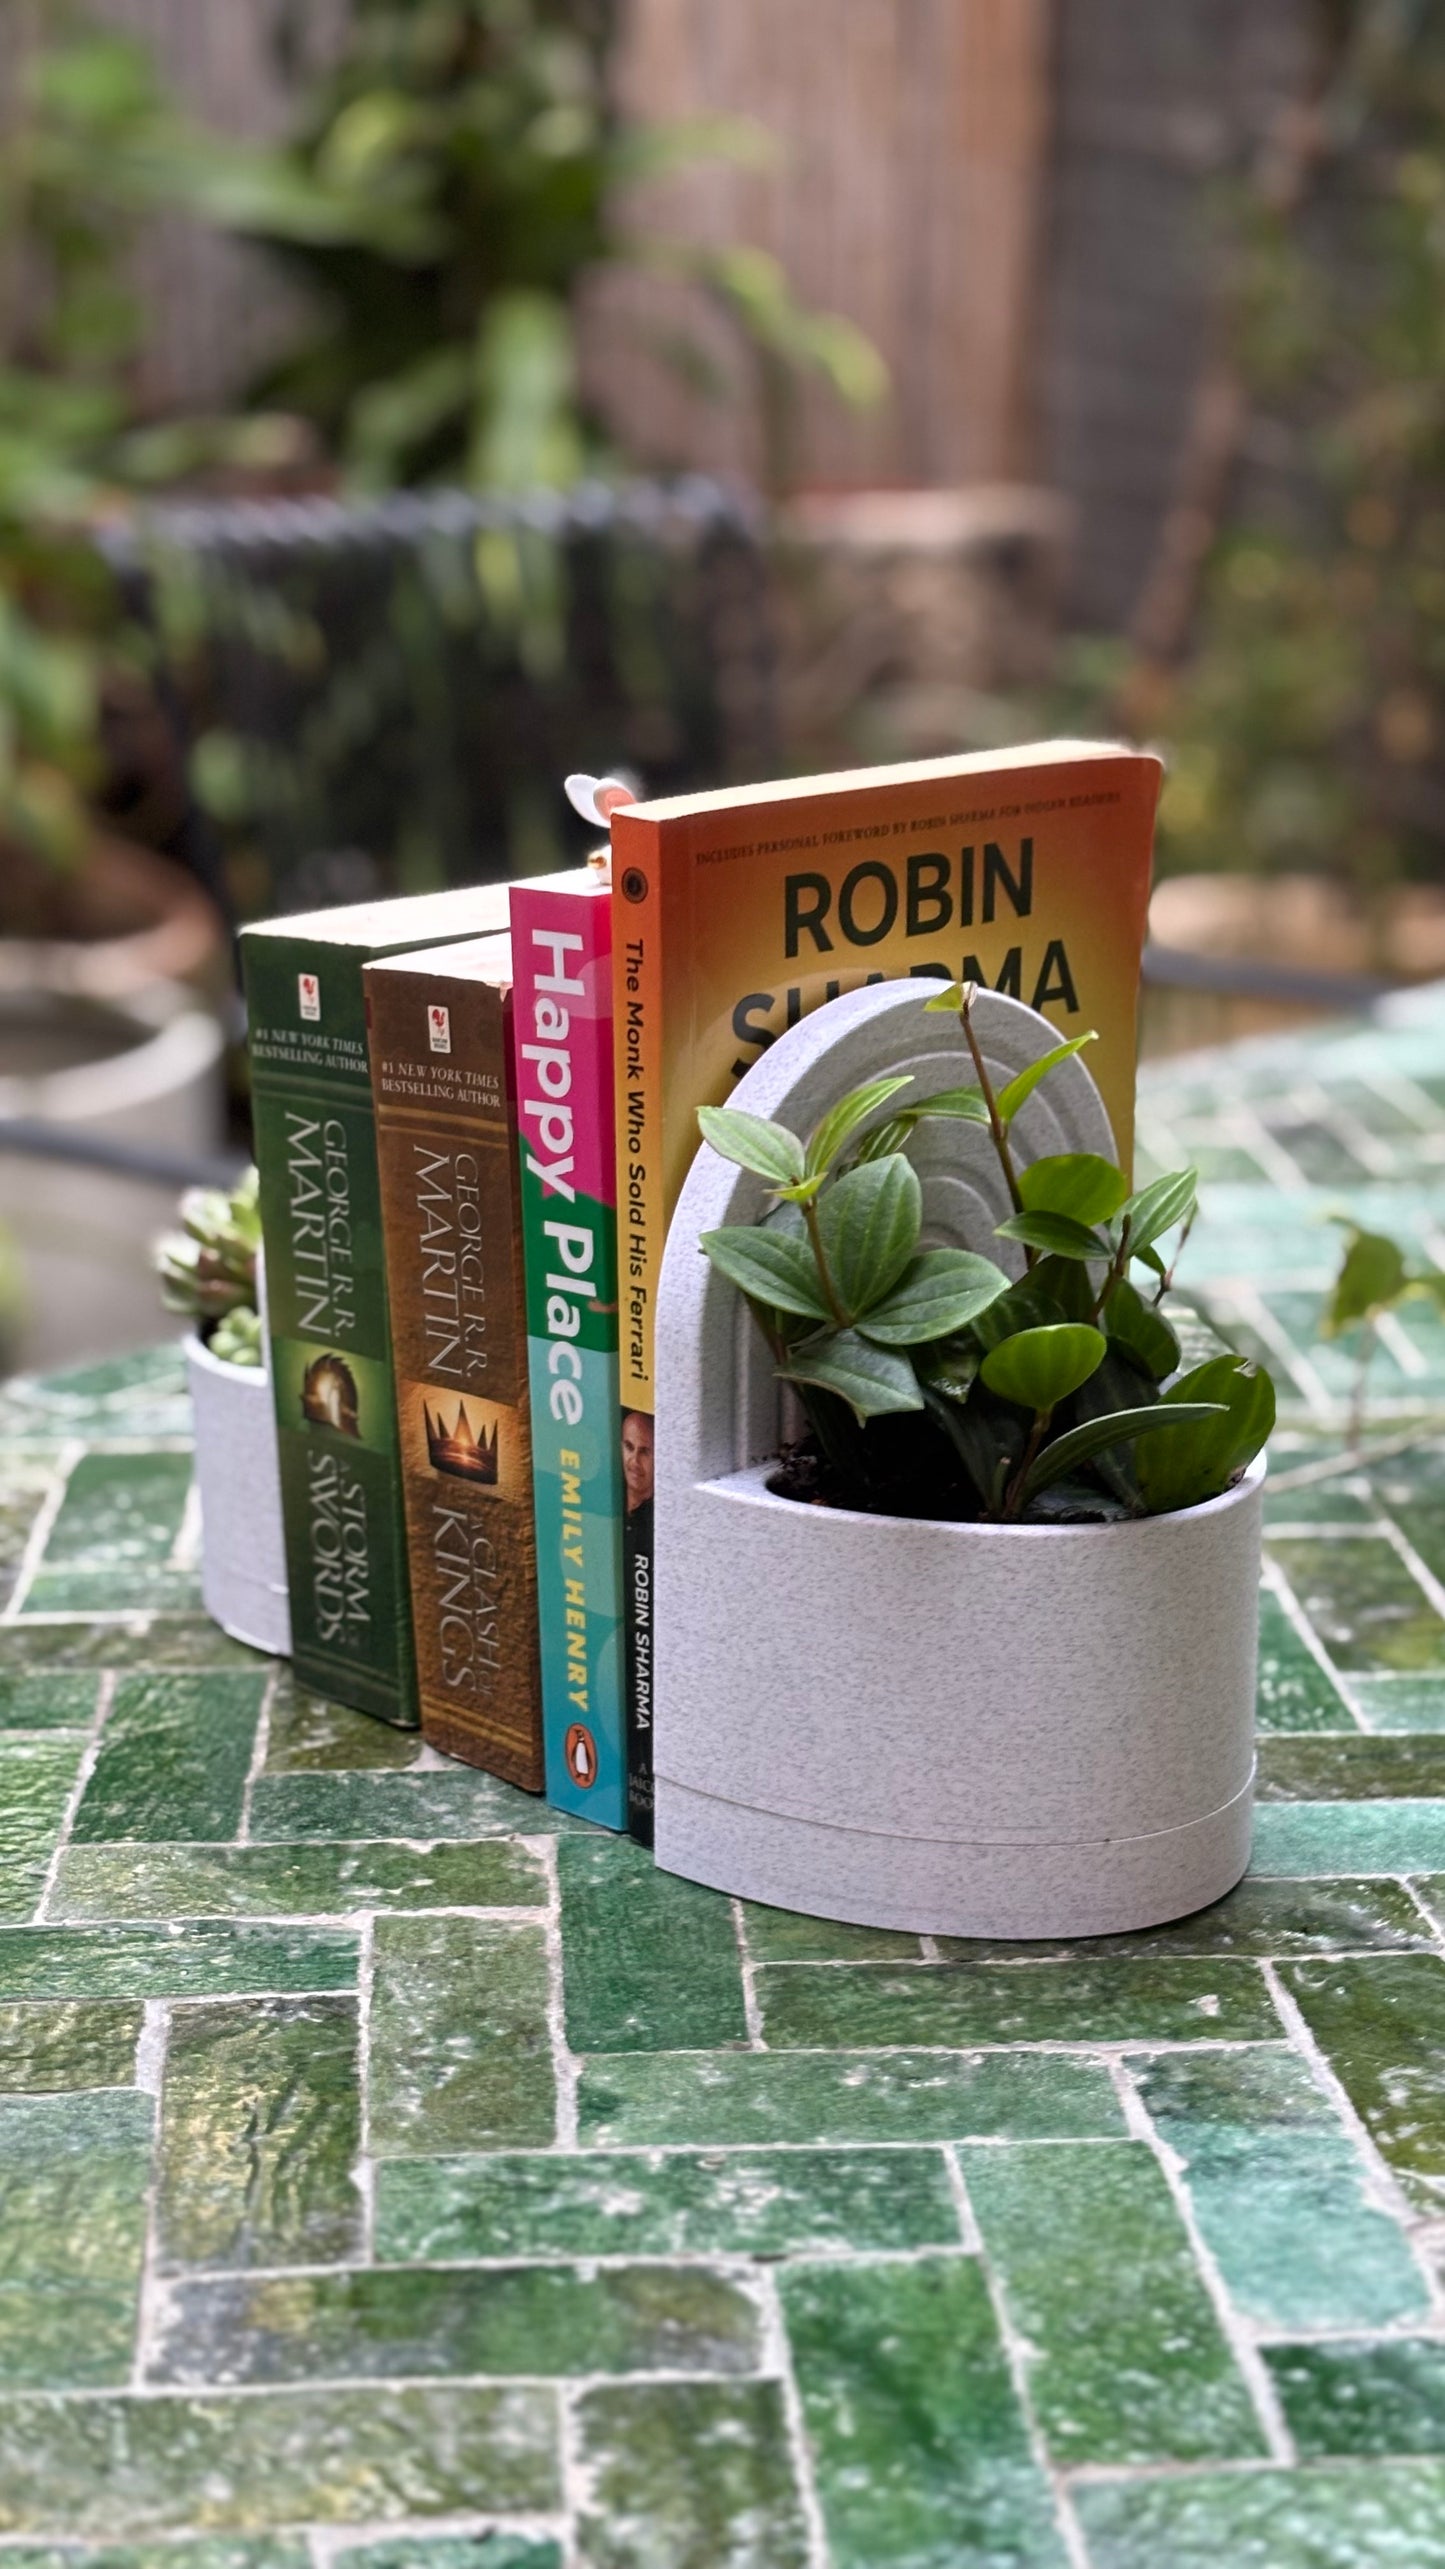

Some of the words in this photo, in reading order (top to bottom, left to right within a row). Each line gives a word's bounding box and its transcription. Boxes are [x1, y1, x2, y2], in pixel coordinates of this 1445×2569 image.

[758, 834, 819, 856] PERSONAL
[822, 823, 889, 846] FOREWORD
[893, 820, 907, 835] BY
[910, 815, 946, 831] ROBIN
[783, 837, 1033, 959] ROBIN
[626, 937, 644, 992] The
[252, 1044, 323, 1066] BESTSELLING
[324, 1054, 369, 1074] AUTHOR
[271, 1029, 299, 1044] NEW
[301, 1033, 331, 1050] YORK
[331, 1038, 364, 1056] TIMES
[381, 1061, 393, 1075] #1
[398, 1062, 427, 1078] NEW
[430, 1066, 463, 1084] YORK
[464, 1071, 499, 1090] TIMES
[381, 1078, 454, 1100] BESTSELLING
[456, 1089, 501, 1108] AUTHOR
[522, 927, 586, 1204] Happy
[626, 1001, 645, 1081] Monk
[627, 1090, 645, 1154] Who
[284, 1110, 333, 1336] MARTIN
[323, 1119, 353, 1264] GEORGE
[454, 1153, 485, 1303] GEORGE
[628, 1162, 647, 1226] Sold
[413, 1144, 463, 1377] MARTIN
[629, 1233, 647, 1277] His
[543, 1220, 596, 1427] Place
[630, 1285, 649, 1381] Ferrari
[306, 1449, 347, 1644] SWORDS
[340, 1478, 372, 1623] STORM
[560, 1447, 583, 1568] EMILY
[432, 1504, 477, 1692] KINGS
[472, 1537, 502, 1669] CLASH
[634, 1552, 650, 1627] ROBIN
[564, 1580, 591, 1713] HENRY
[634, 1632, 652, 1731] SHARMA
